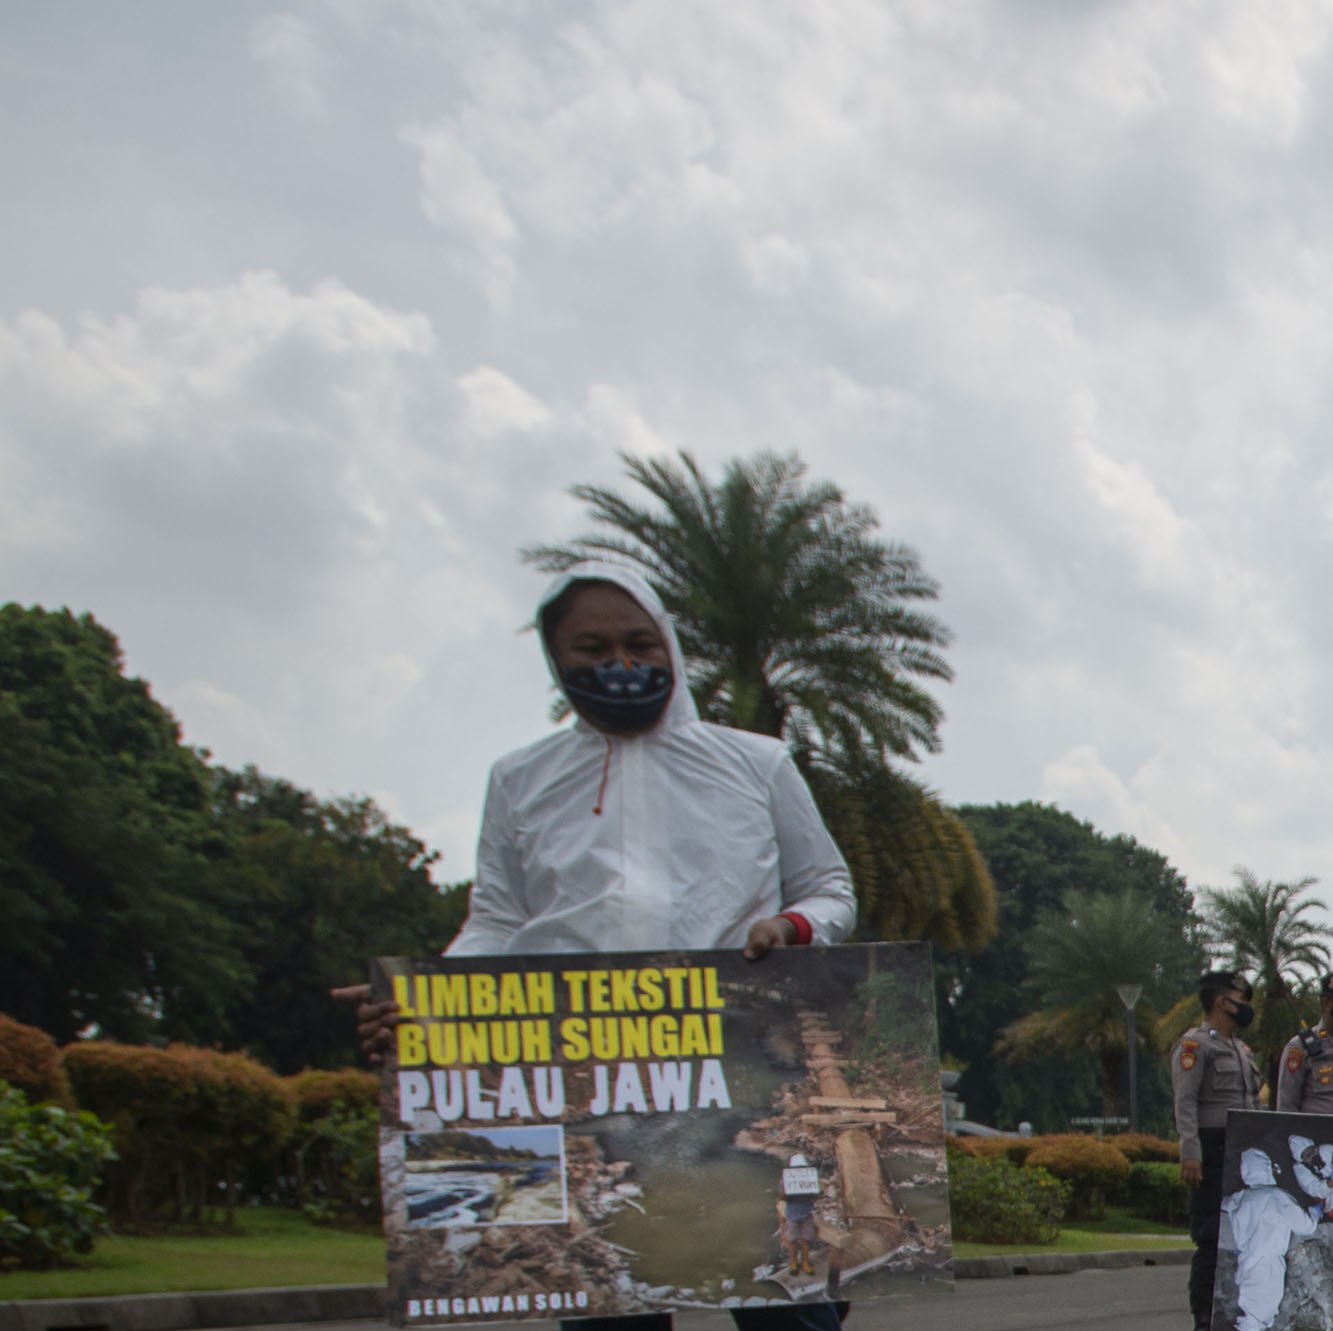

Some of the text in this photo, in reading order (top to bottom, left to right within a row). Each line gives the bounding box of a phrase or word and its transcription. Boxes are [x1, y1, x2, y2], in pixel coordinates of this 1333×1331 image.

[393, 967, 725, 1018] LIMBAH TEKSTIL
[395, 1013, 724, 1066] BUNUH SUNGAI
[397, 1058, 732, 1123] PULAU JAWA
[407, 1290, 589, 1317] BENGAWAN SOLO
